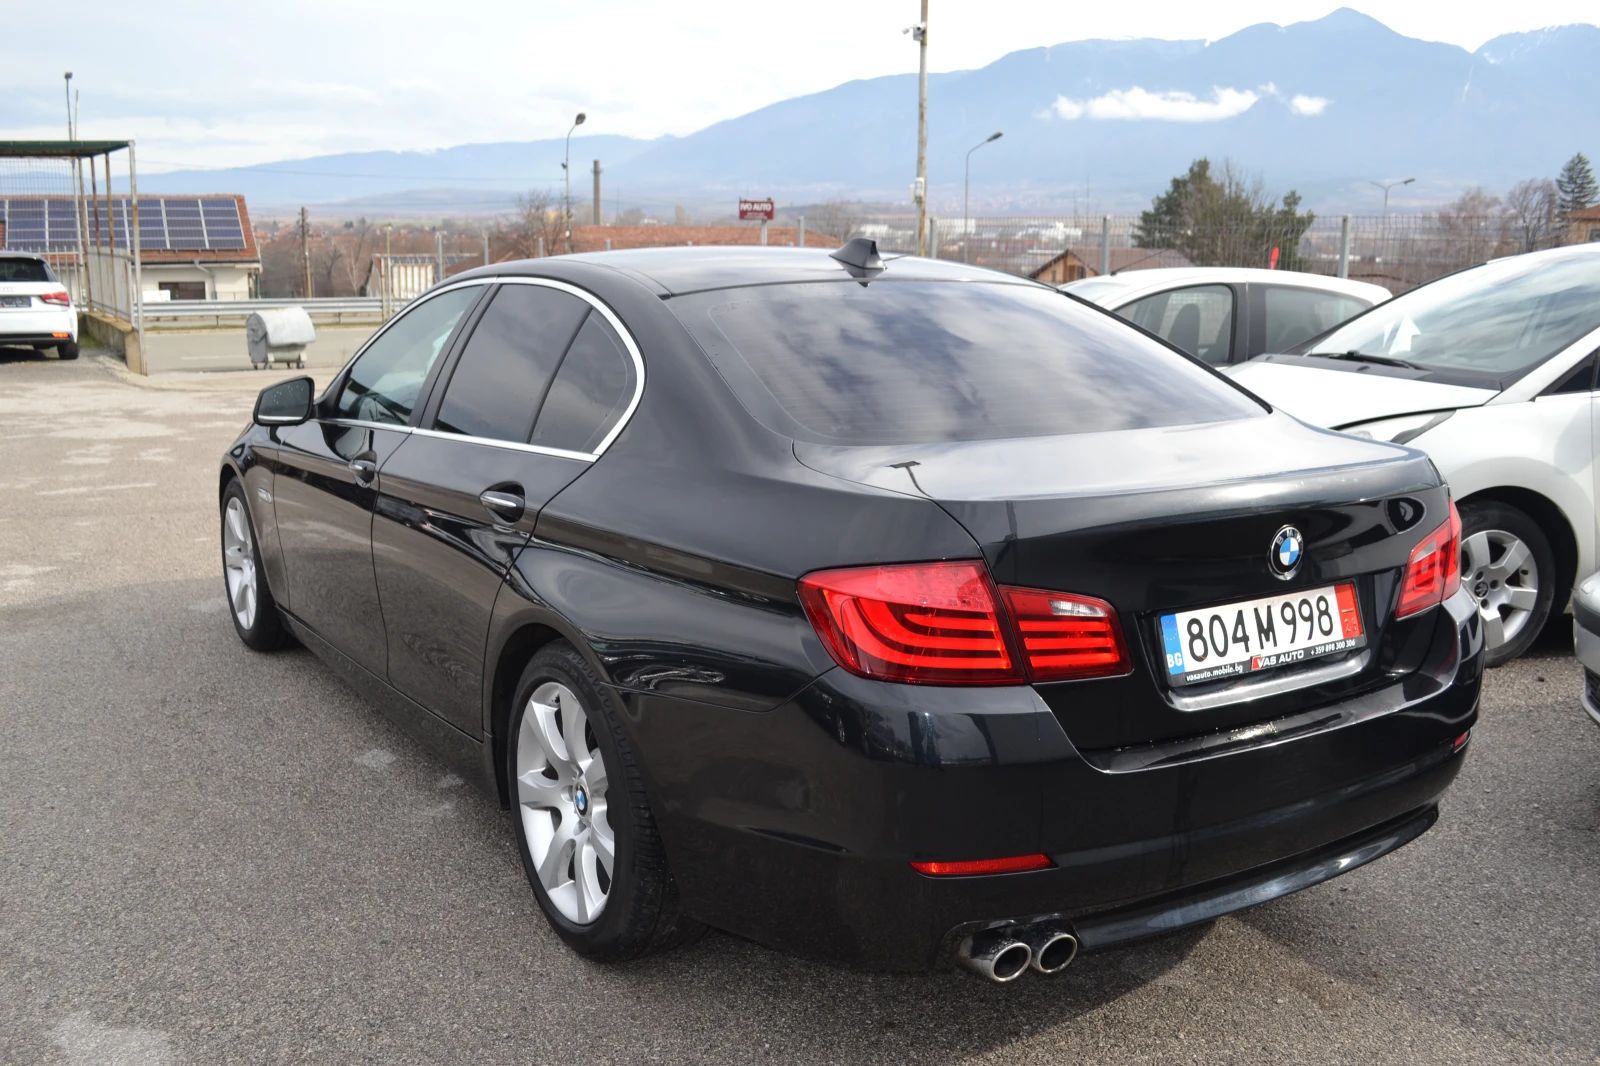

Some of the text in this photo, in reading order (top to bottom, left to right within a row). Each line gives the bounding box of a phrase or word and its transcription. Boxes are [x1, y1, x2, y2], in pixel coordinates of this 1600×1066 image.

[740, 203, 772, 212] IVO AUTO
[1186, 595, 1334, 662] 804 M 998
[1335, 641, 1346, 650] 300
[1346, 638, 1356, 648] 306
[1166, 652, 1183, 668] BG
[1256, 650, 1304, 668] VAS AUTO
[1186, 663, 1243, 682] vasauto.mobile.bg
